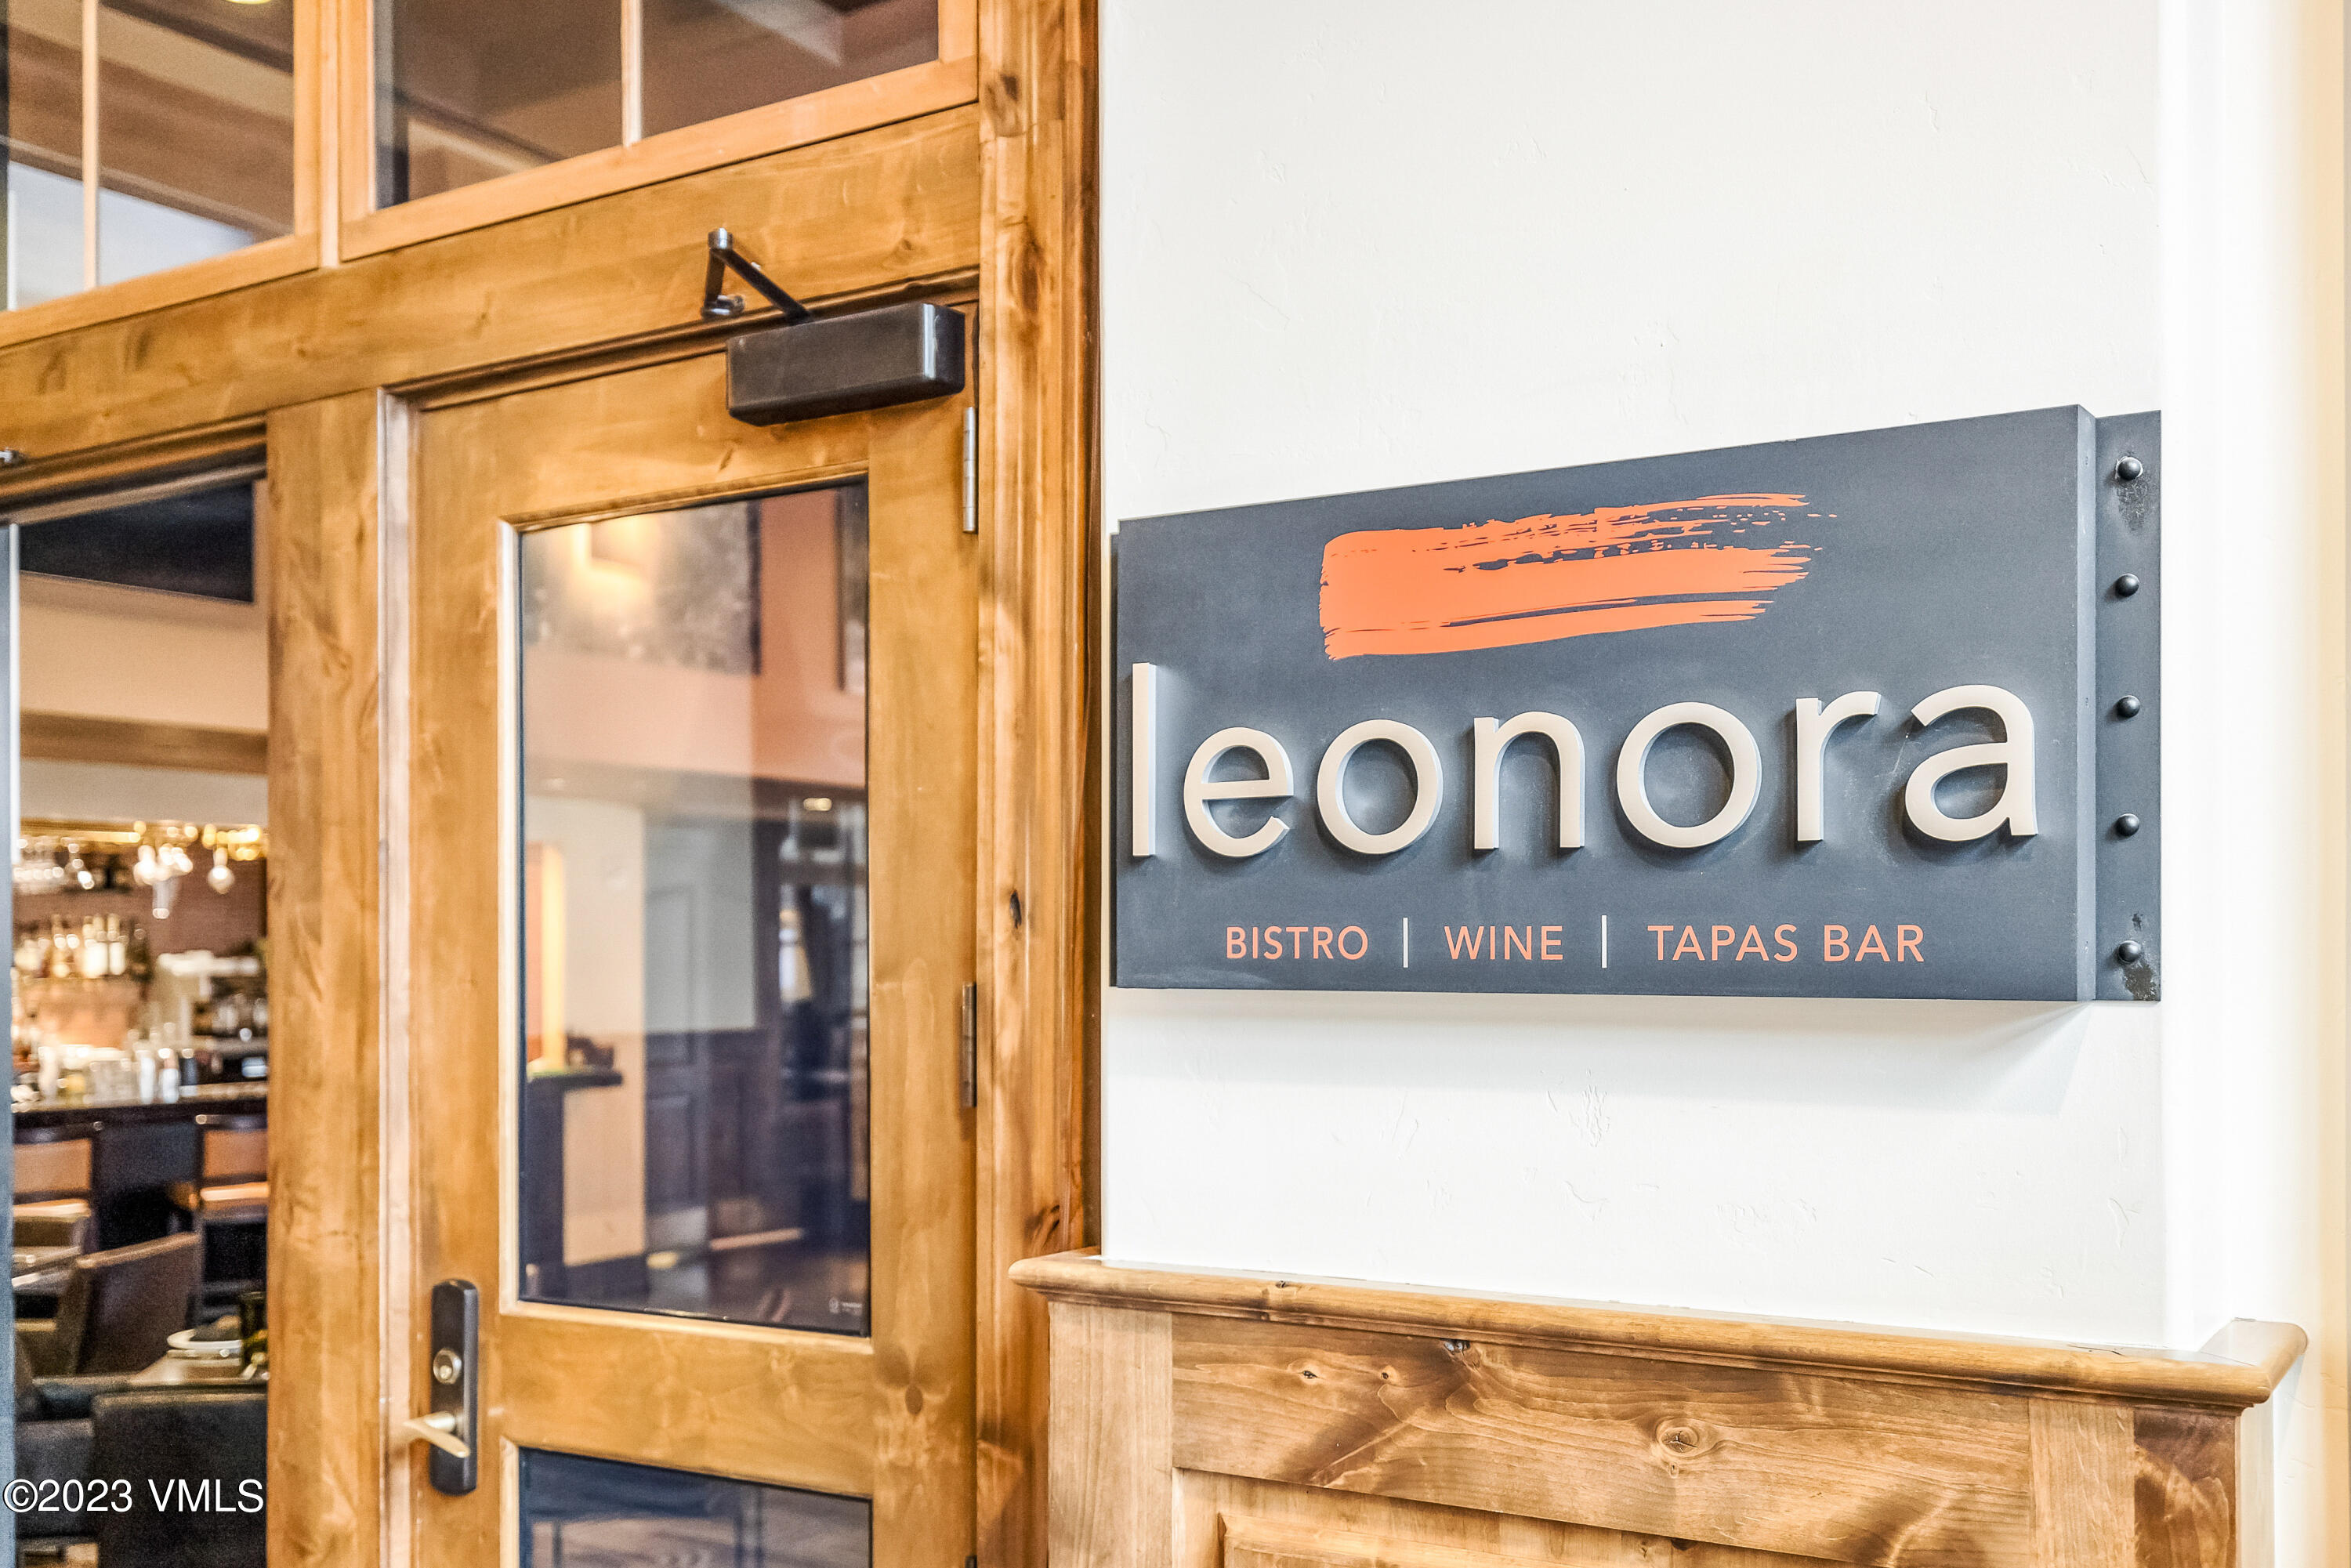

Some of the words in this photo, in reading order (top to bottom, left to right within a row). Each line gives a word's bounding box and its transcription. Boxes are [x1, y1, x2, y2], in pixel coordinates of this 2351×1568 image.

[1132, 661, 2038, 858] leonora
[1225, 925, 1369, 961] BISTRO
[1444, 925, 1564, 961] WINE
[1646, 923, 1799, 962] TAPAS
[1823, 924, 1925, 962] BAR
